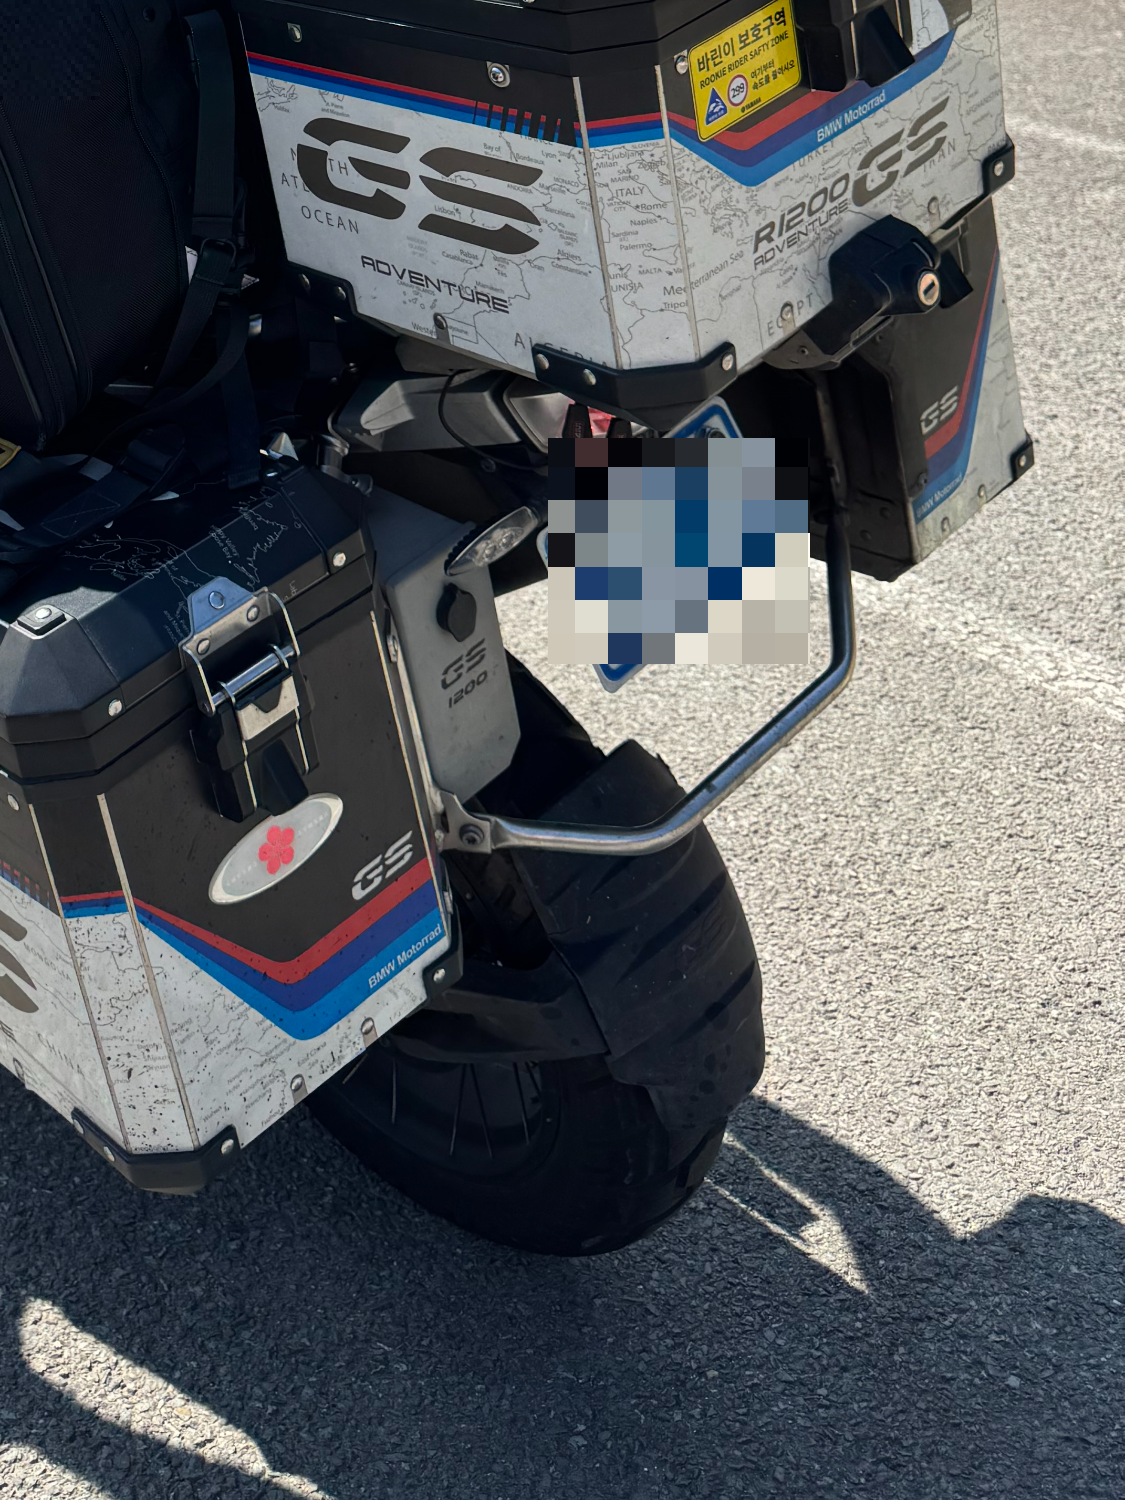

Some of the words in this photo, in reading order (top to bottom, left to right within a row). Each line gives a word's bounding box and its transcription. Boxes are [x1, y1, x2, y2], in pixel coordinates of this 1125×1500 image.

[697, 37, 735, 72] 바린이
[738, 7, 787, 51] 보호구역
[700, 67, 727, 89] ROOKIE
[727, 53, 749, 74] RIDER
[749, 42, 770, 60] SAFTY
[770, 30, 789, 48] ZONE
[730, 82, 745, 99] 299
[816, 118, 843, 143] BMW
[843, 89, 887, 125] Motorrad
[542, 150, 557, 161] Lyon
[595, 160, 619, 169] Milan
[297, 117, 544, 255] GS
[615, 185, 645, 198] ITALY
[753, 173, 850, 255] R1200
[852, 96, 950, 207] GS
[301, 205, 360, 235] OCEAN
[434, 204, 456, 217] Lisbon
[630, 218, 658, 229] Naples
[639, 202, 668, 211] Rome
[611, 229, 639, 239] Sardinia
[619, 242, 653, 251] Palermo
[754, 198, 849, 271] ADVENTURE
[638, 267, 663, 275] MALTA
[729, 249, 745, 263] Sea
[361, 255, 511, 314] ADVENTURE
[920, 386, 959, 435] GS
[441, 637, 487, 690] GS
[449, 670, 488, 709] 1200
[352, 830, 413, 901] GS
[368, 958, 396, 989] BMW
[396, 923, 443, 967] Motorrad
